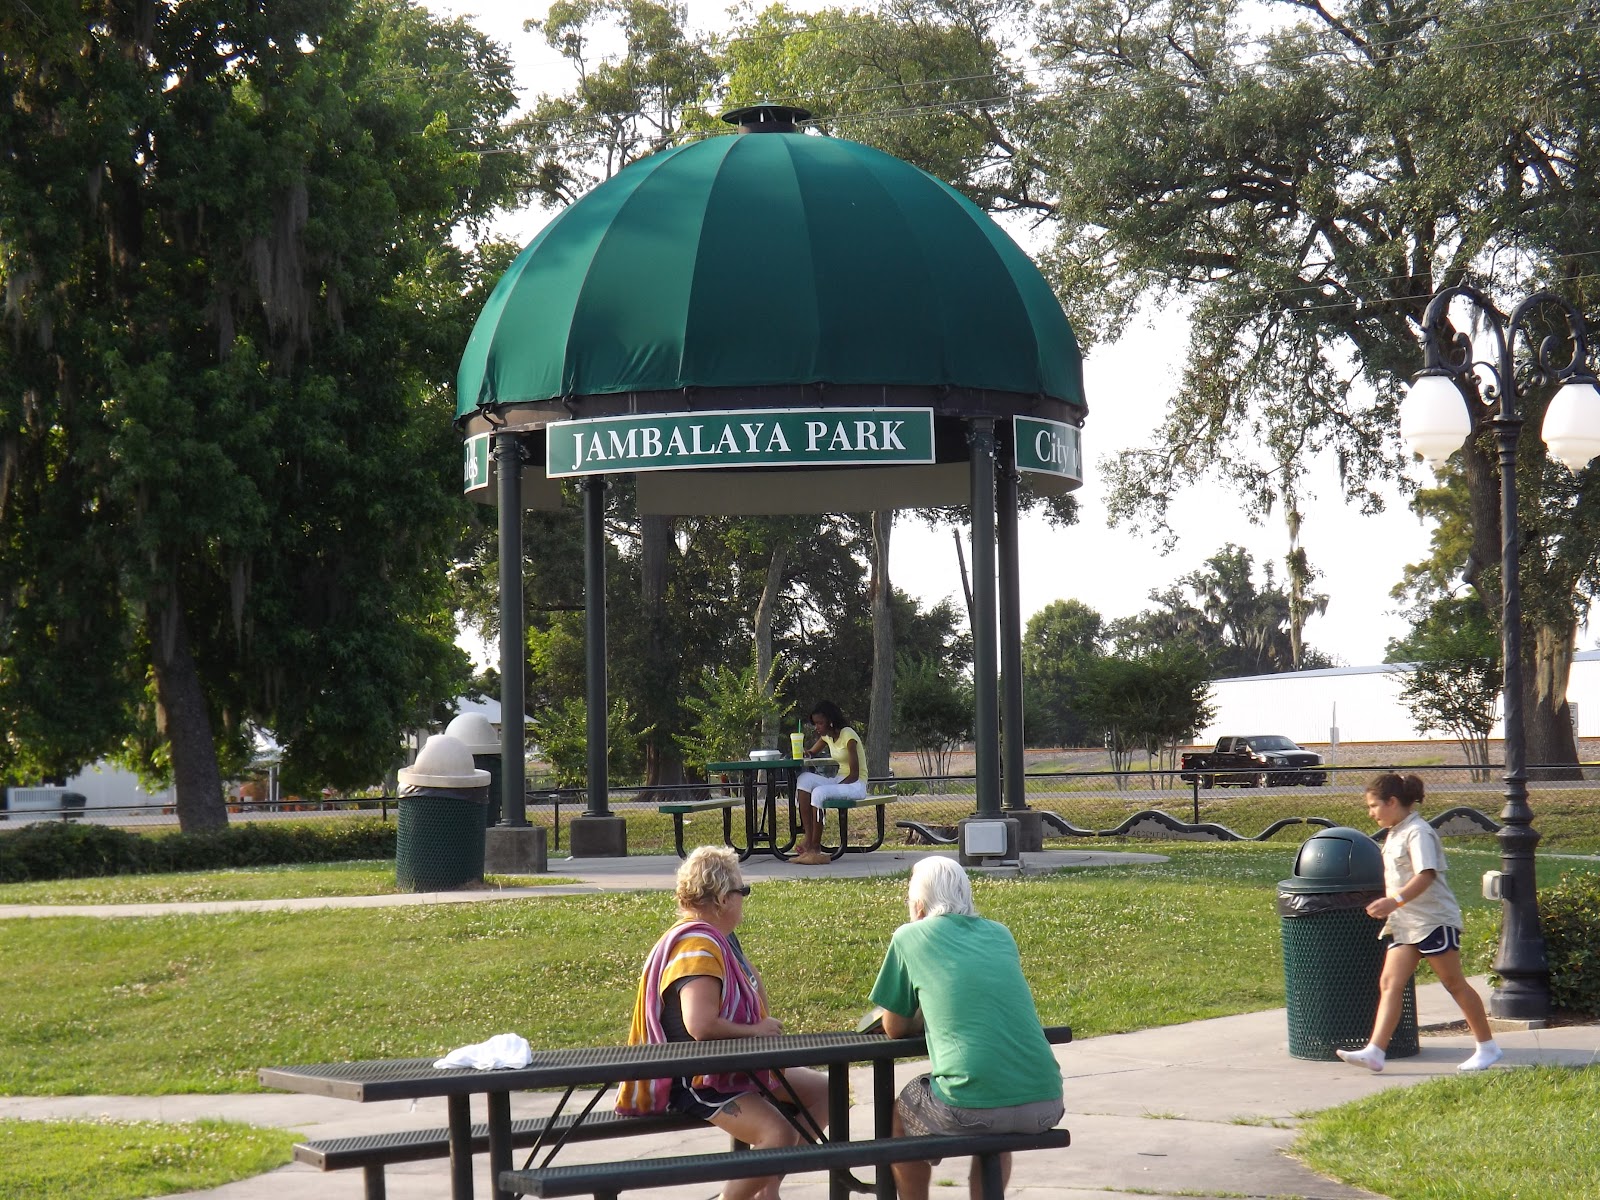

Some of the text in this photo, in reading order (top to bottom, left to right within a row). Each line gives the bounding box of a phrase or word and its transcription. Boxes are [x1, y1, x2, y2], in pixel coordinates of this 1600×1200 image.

[572, 420, 907, 470] JAMBALAYA PARK
[1035, 429, 1070, 473] City
